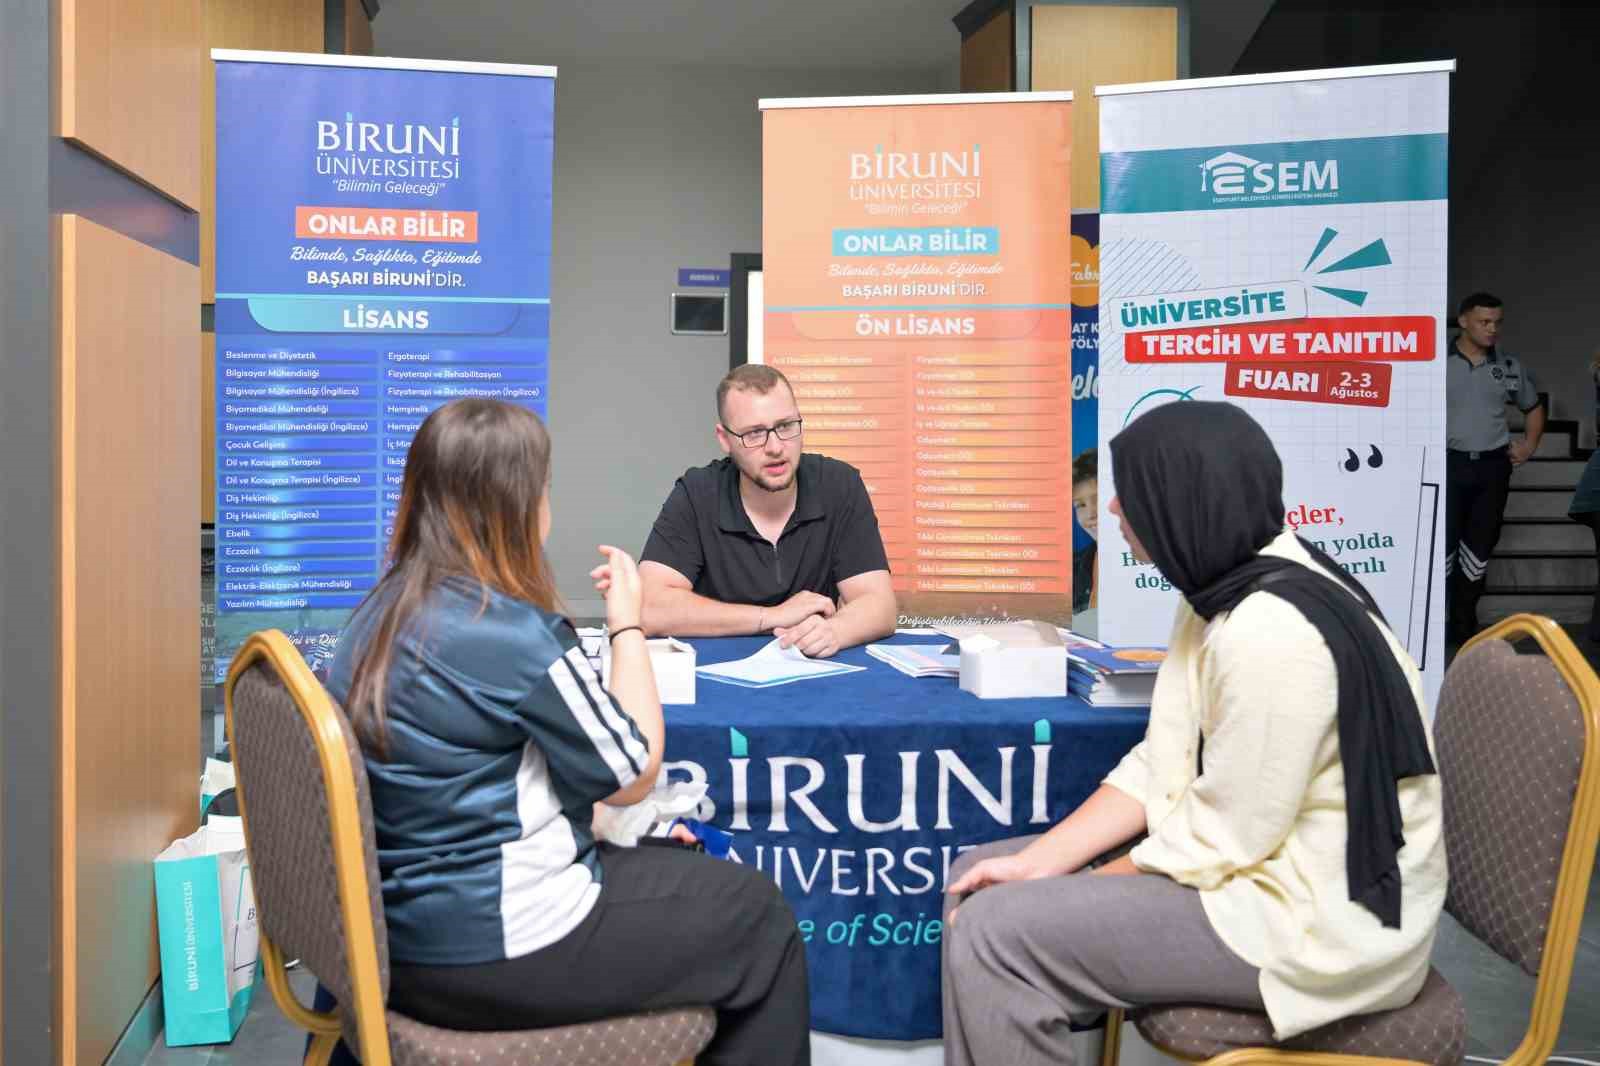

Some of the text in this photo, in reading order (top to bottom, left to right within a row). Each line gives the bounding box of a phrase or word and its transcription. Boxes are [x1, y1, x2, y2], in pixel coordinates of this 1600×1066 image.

[316, 112, 460, 156] BİRUNİ
[316, 153, 460, 179] ÜNİVERSİTESİ
[849, 143, 983, 180] BİRUNİ
[848, 178, 982, 201] ÜNİVERSİTESİ
[308, 211, 466, 239] ONLAR BİLİR
[843, 229, 988, 253] ONLAR BİLİR
[289, 246, 483, 268] Bilimde, Sağlıkta, Eğitimde
[307, 270, 369, 289] BAŞARI
[842, 284, 898, 300] BAŞARI
[343, 304, 429, 329] LİSANS
[1120, 290, 1287, 329] ÜNİVERSİTE
[855, 313, 976, 336] ÖN LİSANS
[1142, 328, 1418, 357] TERCİH VE TANITIM
[388, 351, 430, 362] Ergoterapi
[225, 368, 266, 379] Bilgisayar
[1237, 368, 1320, 393] FUARI
[1338, 371, 1373, 388] 2-3
[1330, 385, 1379, 400] Ağustos
[225, 439, 251, 451] Çocuk
[1287, 504, 1345, 531] çler,
[1332, 532, 1395, 556] yolda
[826, 912, 867, 946] of
[868, 912, 943, 946] Scie
